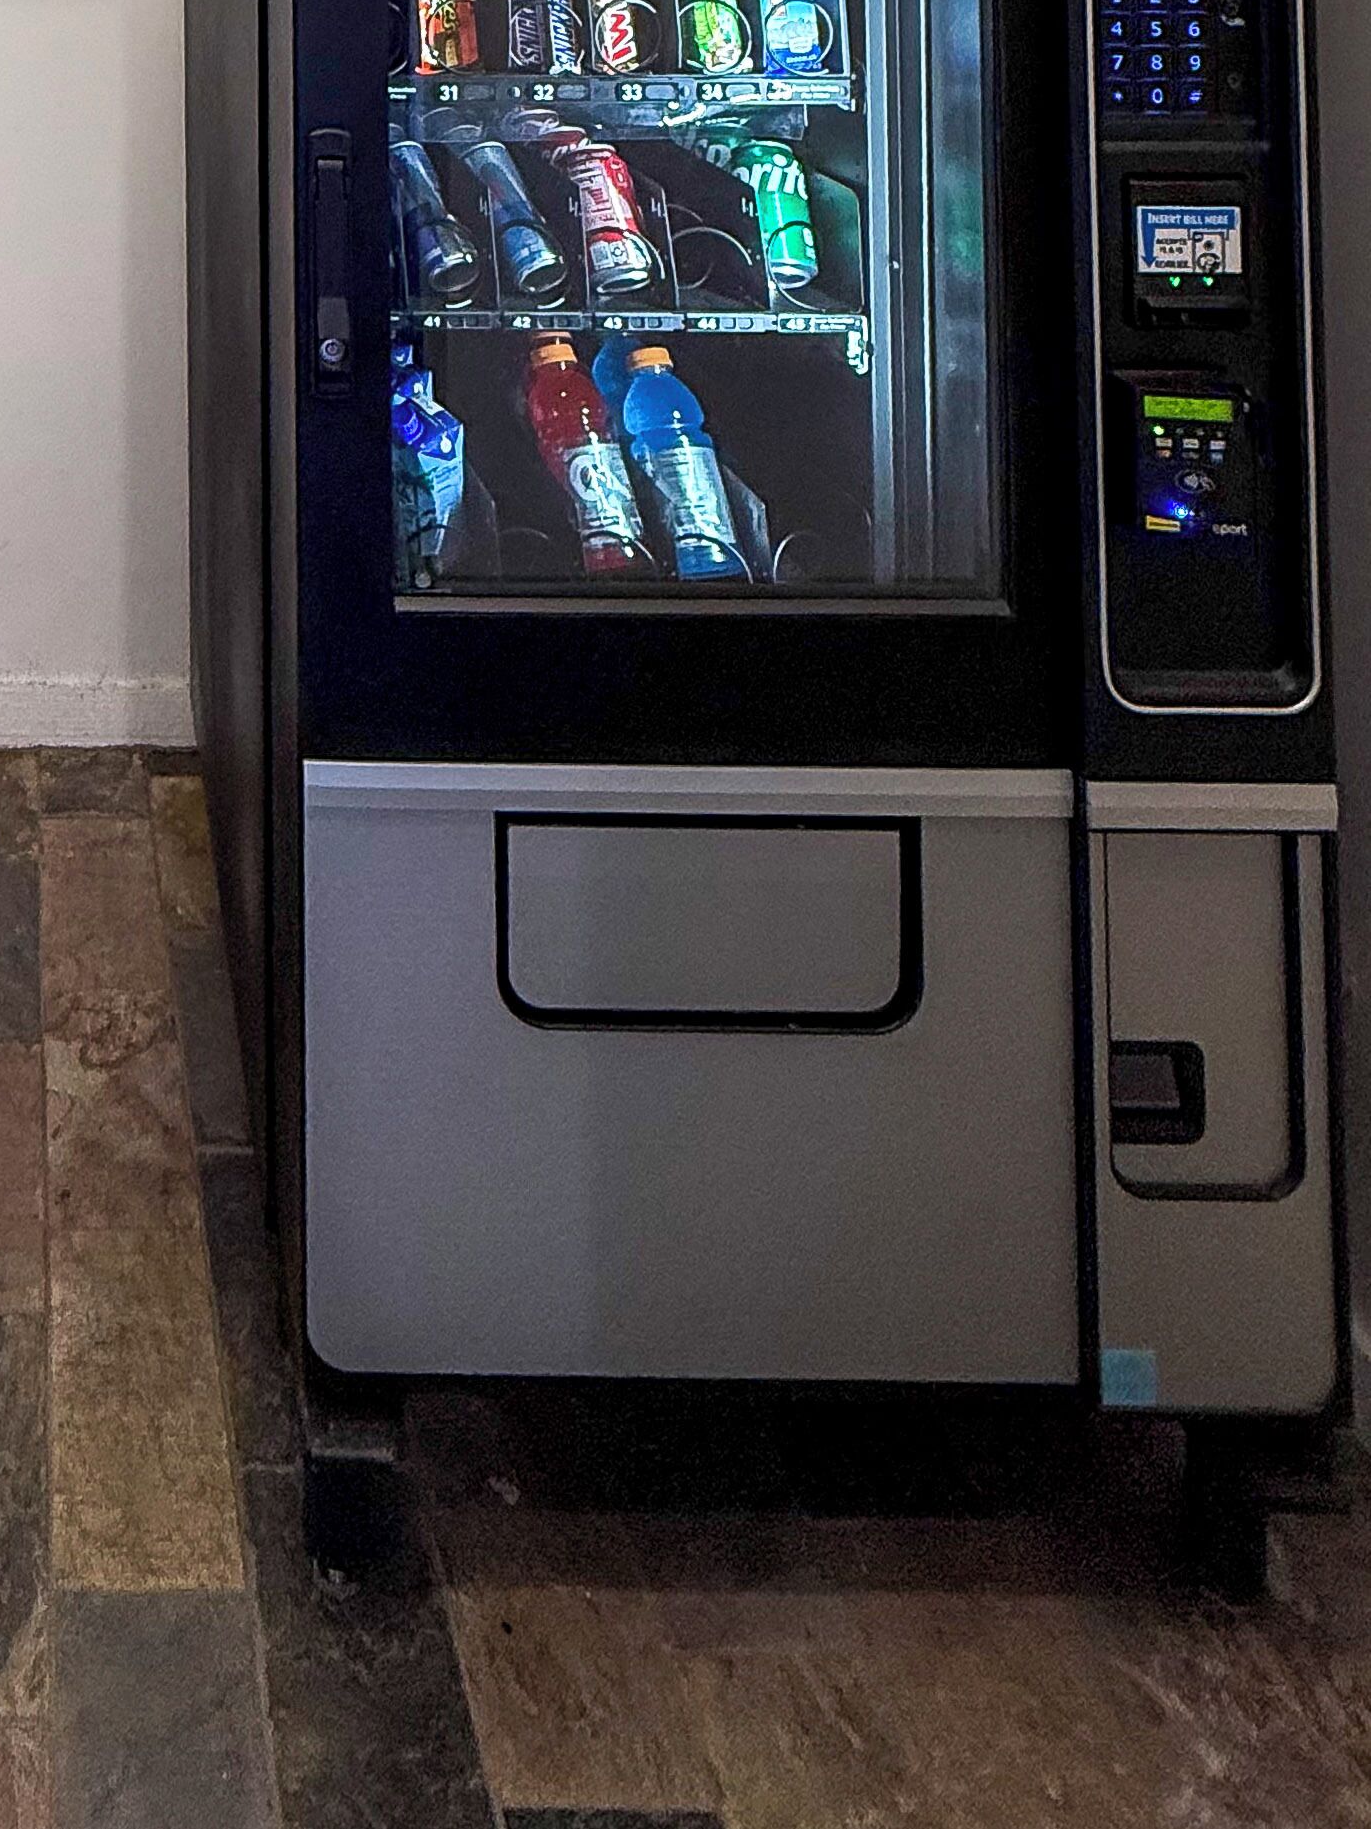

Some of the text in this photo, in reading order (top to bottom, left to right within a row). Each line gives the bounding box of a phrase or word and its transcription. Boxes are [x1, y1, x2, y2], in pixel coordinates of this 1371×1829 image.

[1111, 21, 1200, 37] 4 5 6
[1112, 55, 1201, 71] 7 8 9
[439, 85, 458, 101] 31
[533, 84, 554, 101] 32
[621, 84, 643, 101] 33
[701, 83, 724, 101] 34
[1152, 88, 1163, 103] 0
[1147, 212, 1182, 224] INSERT
[424, 316, 441, 328] 41
[513, 316, 531, 328] 42
[604, 316, 623, 329] 43
[697, 318, 717, 329] 44
